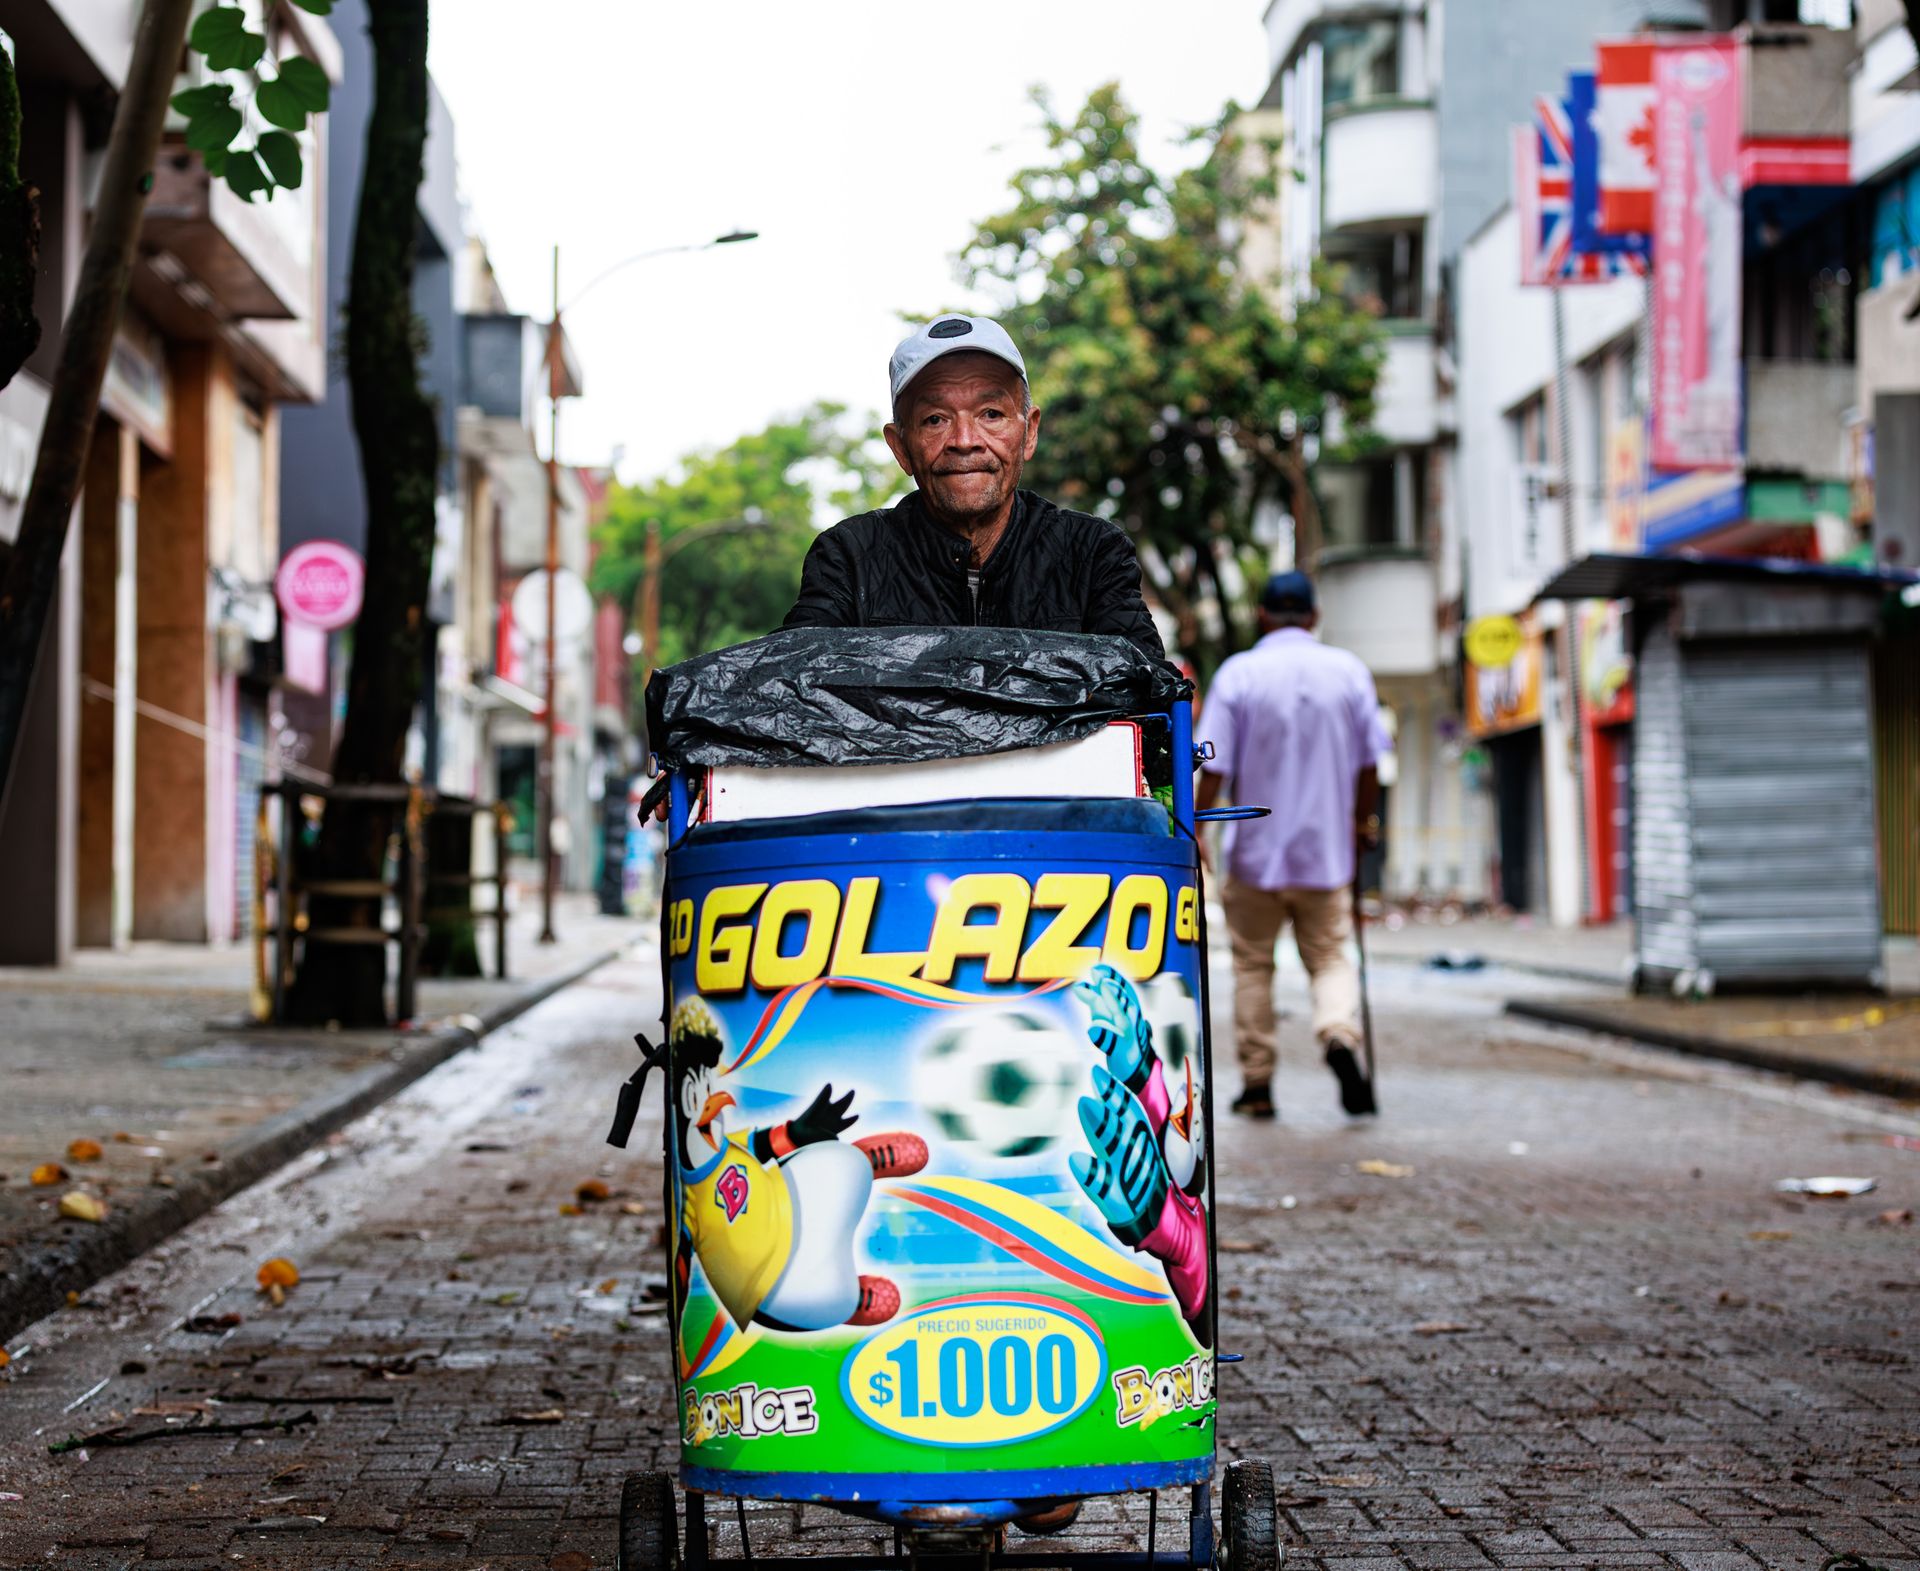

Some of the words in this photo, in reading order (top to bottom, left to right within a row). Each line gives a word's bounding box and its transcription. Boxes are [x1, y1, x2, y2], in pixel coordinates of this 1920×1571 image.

[696, 873, 1168, 993] GOLAZO
[717, 1165, 748, 1223] B
[917, 1319, 970, 1333] PRECIO
[975, 1317, 1047, 1332] SUGERIDO
[869, 1333, 1077, 1418] $1.000
